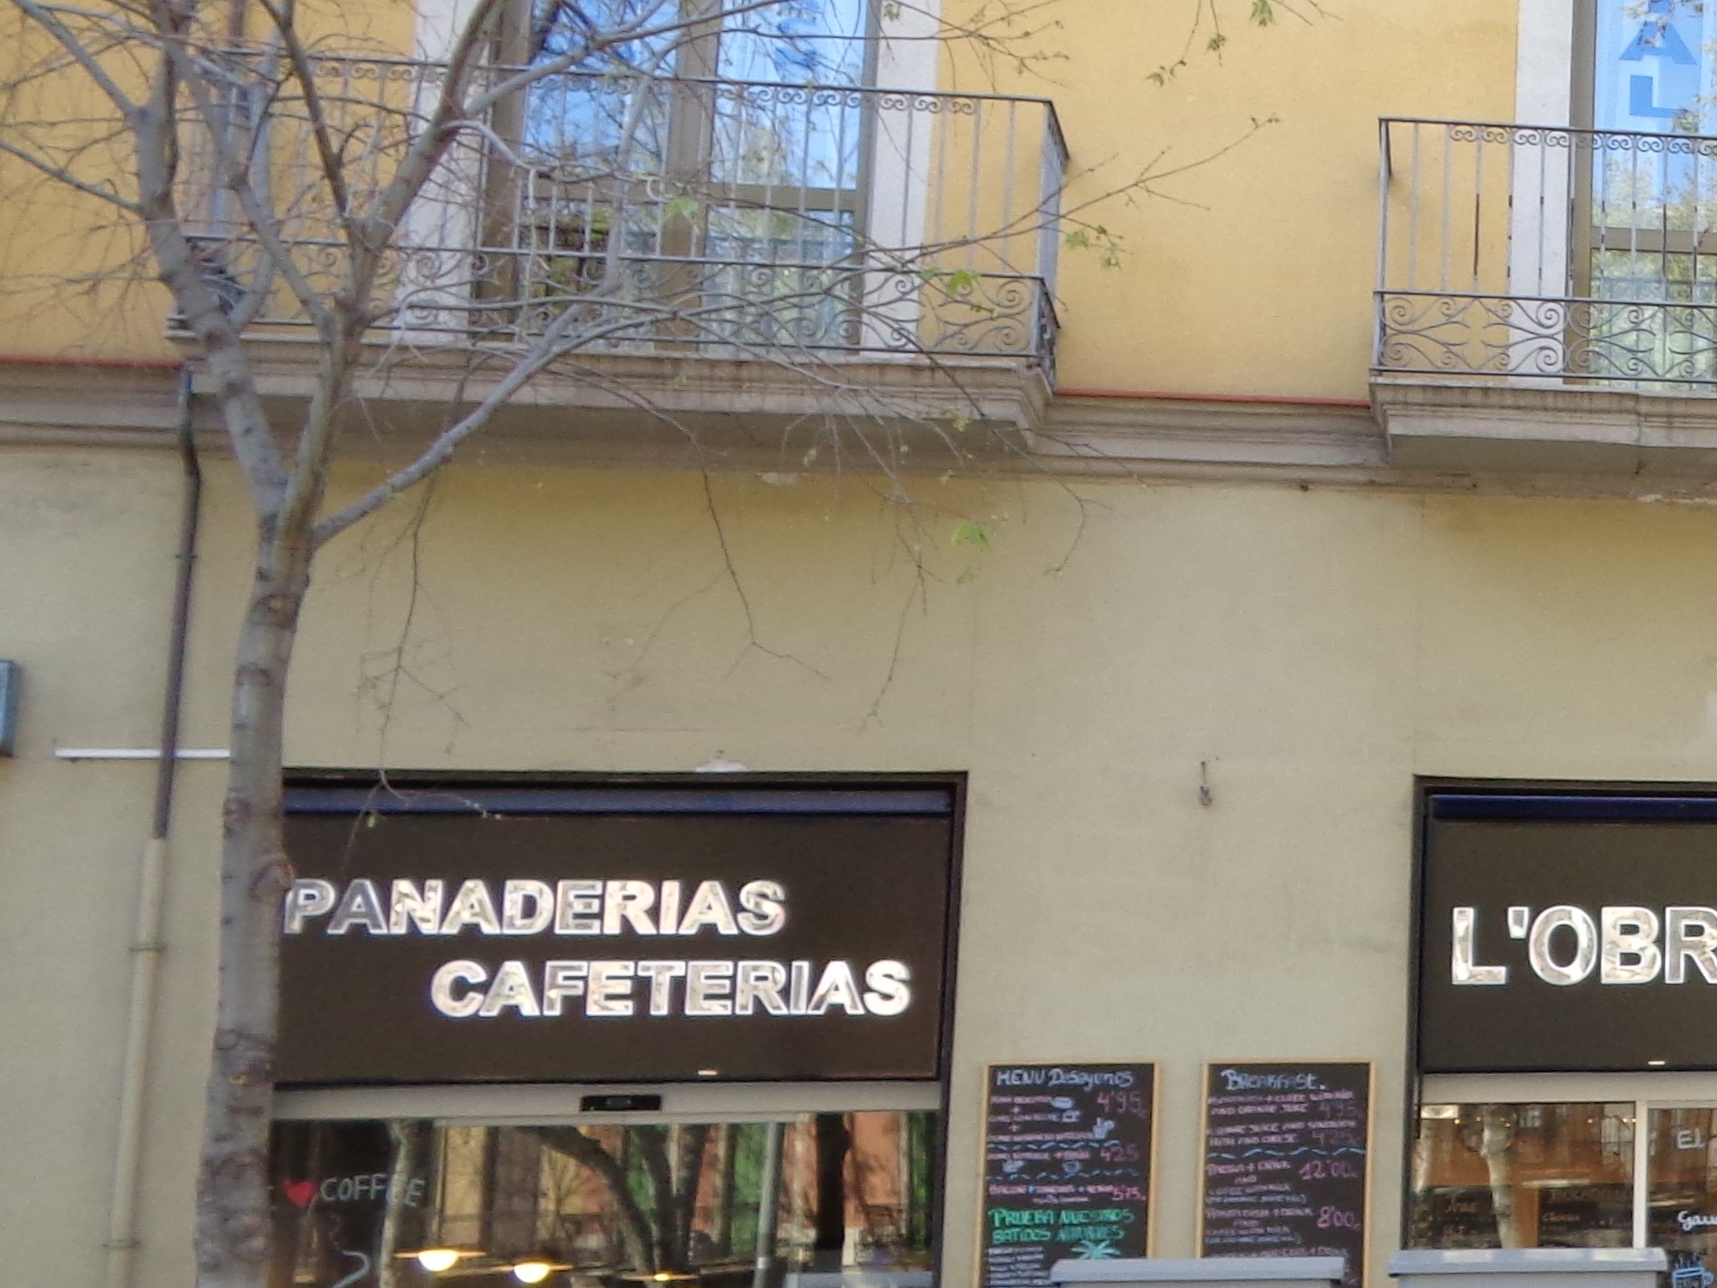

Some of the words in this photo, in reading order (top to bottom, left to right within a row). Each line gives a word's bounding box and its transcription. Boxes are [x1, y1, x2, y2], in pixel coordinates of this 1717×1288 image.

[282, 877, 788, 937] PANADERIAS
[430, 958, 915, 1018] CAFETERIAS
[988, 1207, 1054, 1227] PRUEBA
